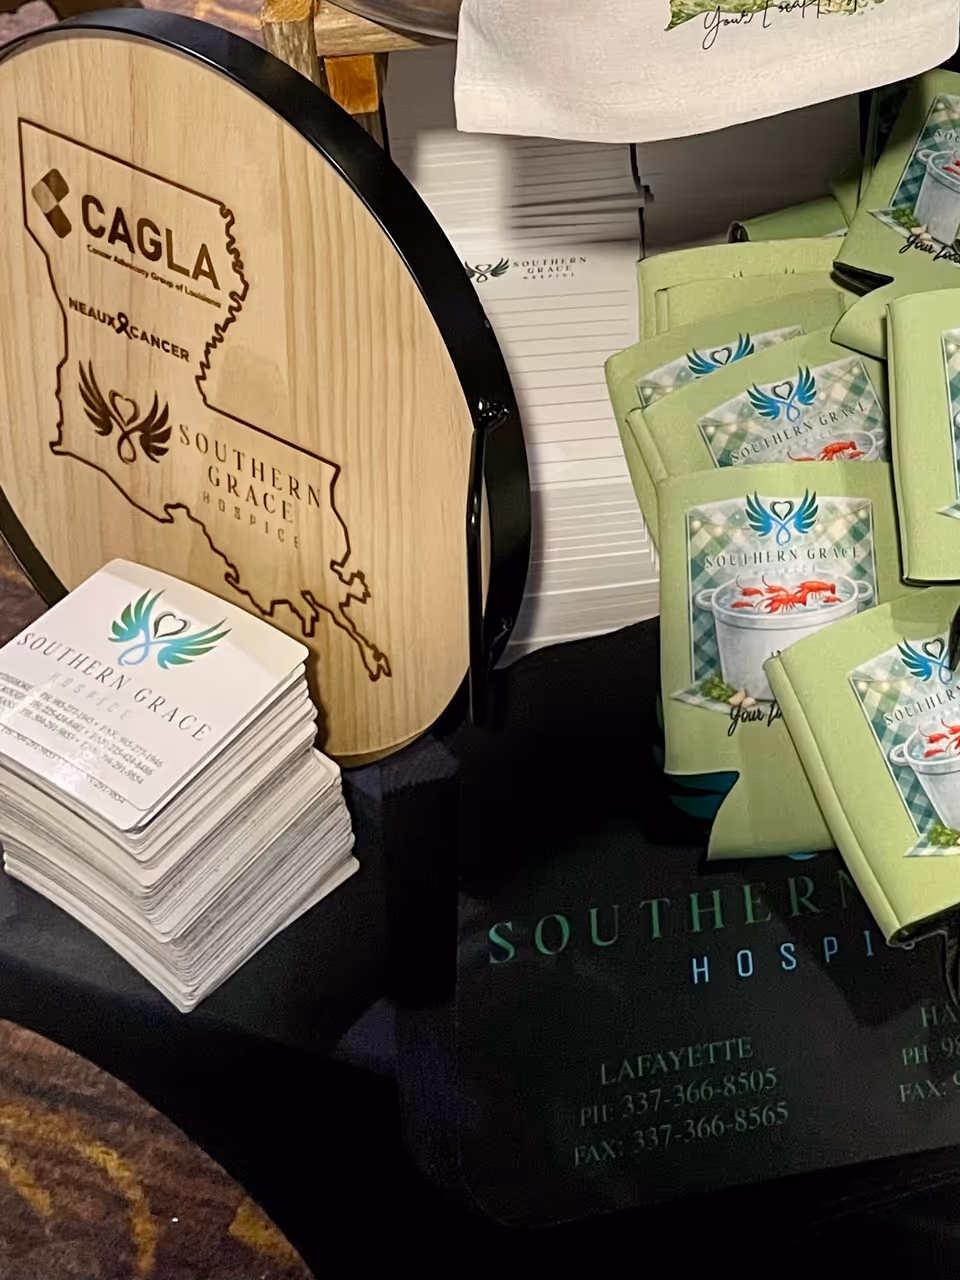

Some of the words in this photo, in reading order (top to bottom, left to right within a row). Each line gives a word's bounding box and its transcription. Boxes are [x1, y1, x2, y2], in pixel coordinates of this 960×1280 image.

[81, 194, 221, 290] CAGLA
[179, 424, 321, 508] SOUTHERN
[208, 465, 293, 523] GRACE
[202, 491, 300, 549] HOSPICE
[704, 549, 799, 569] SOUTHERN
[807, 546, 860, 560] GRACE
[17, 632, 131, 690] SOUTHERN
[134, 687, 212, 741] GRACE
[692, 929, 915, 984] HOSPI
[601, 1037, 753, 1086] LAFAYETTE
[900, 1079, 946, 1102] FAX:
[622, 1068, 778, 1118] 337-366-8505
[575, 1140, 623, 1166] FAX:
[633, 1102, 788, 1153] 337-366-8565
